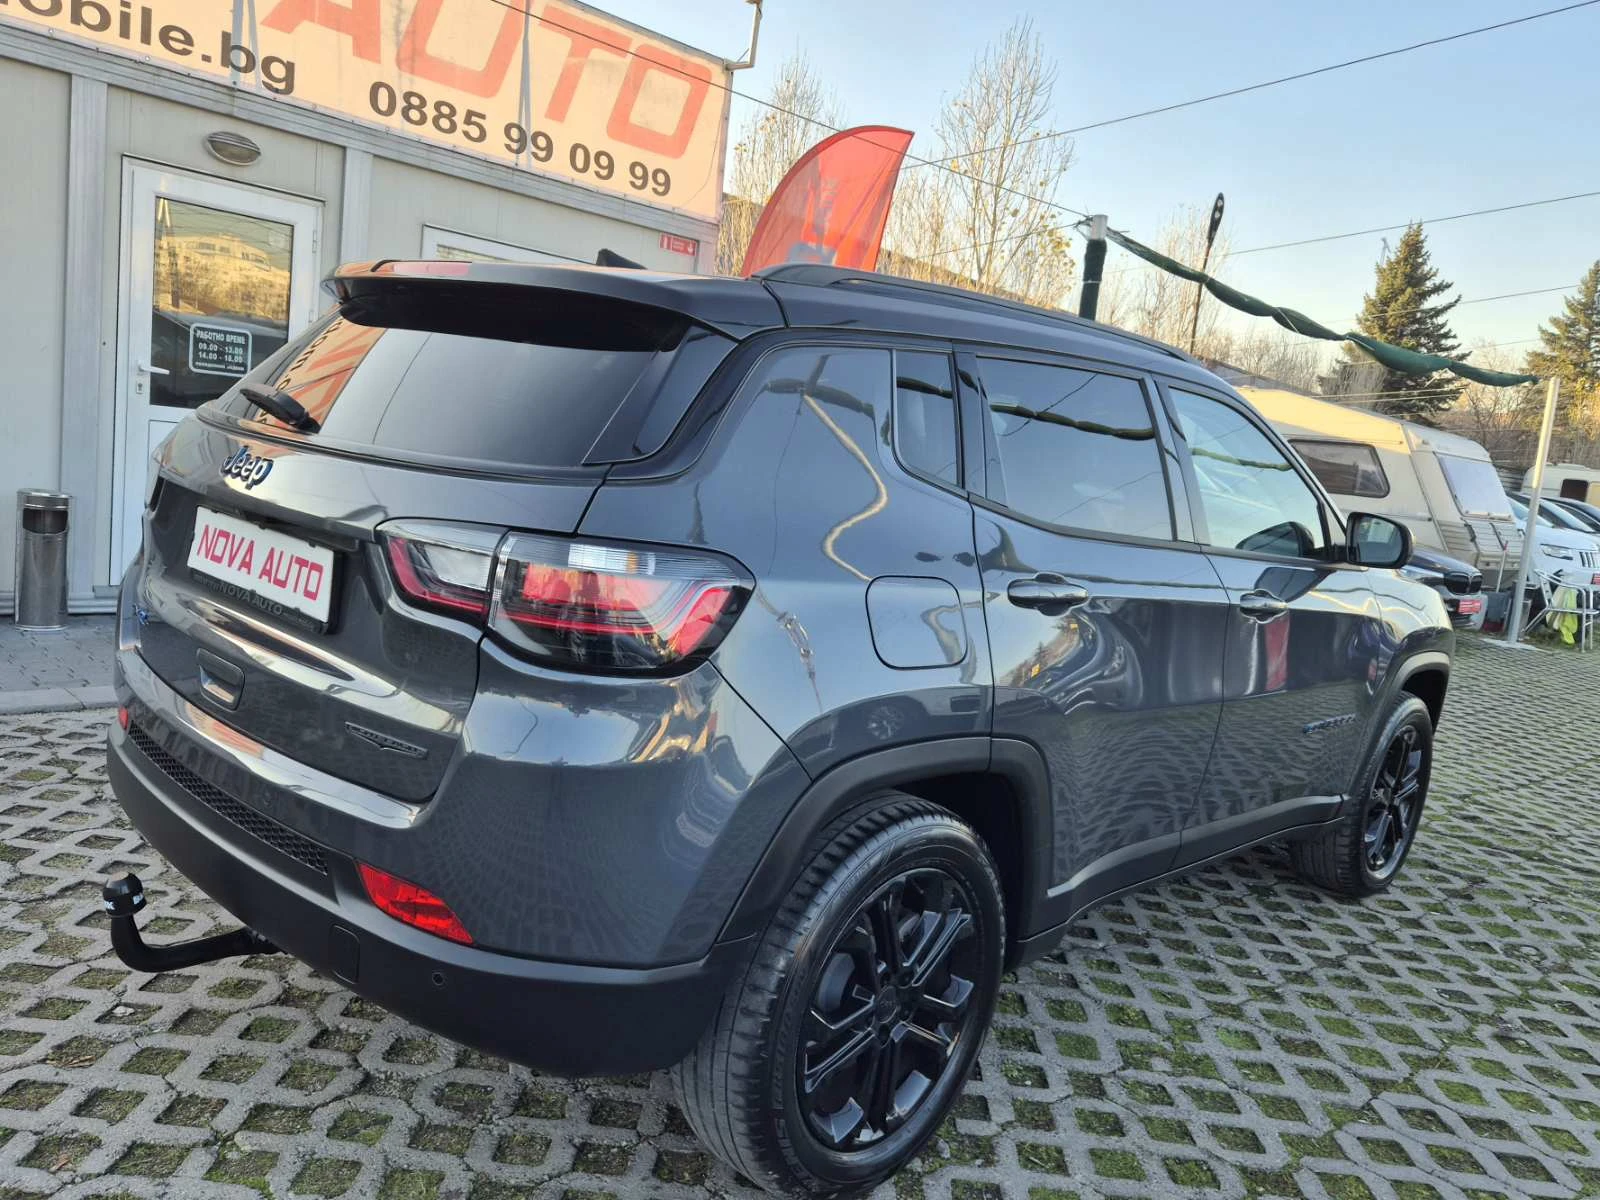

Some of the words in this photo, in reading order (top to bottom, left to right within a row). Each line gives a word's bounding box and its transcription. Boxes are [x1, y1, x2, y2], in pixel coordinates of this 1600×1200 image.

[0, 0, 295, 95] obile.bg
[369, 80, 488, 144] 0885
[503, 121, 554, 163] 99
[569, 142, 615, 181] 09
[628, 161, 671, 197] 99
[221, 446, 275, 490] Jeep
[196, 524, 255, 576] NOVA
[258, 547, 324, 602] AUTO
[219, 581, 251, 603] NOVA
[252, 595, 284, 616] AUTO
